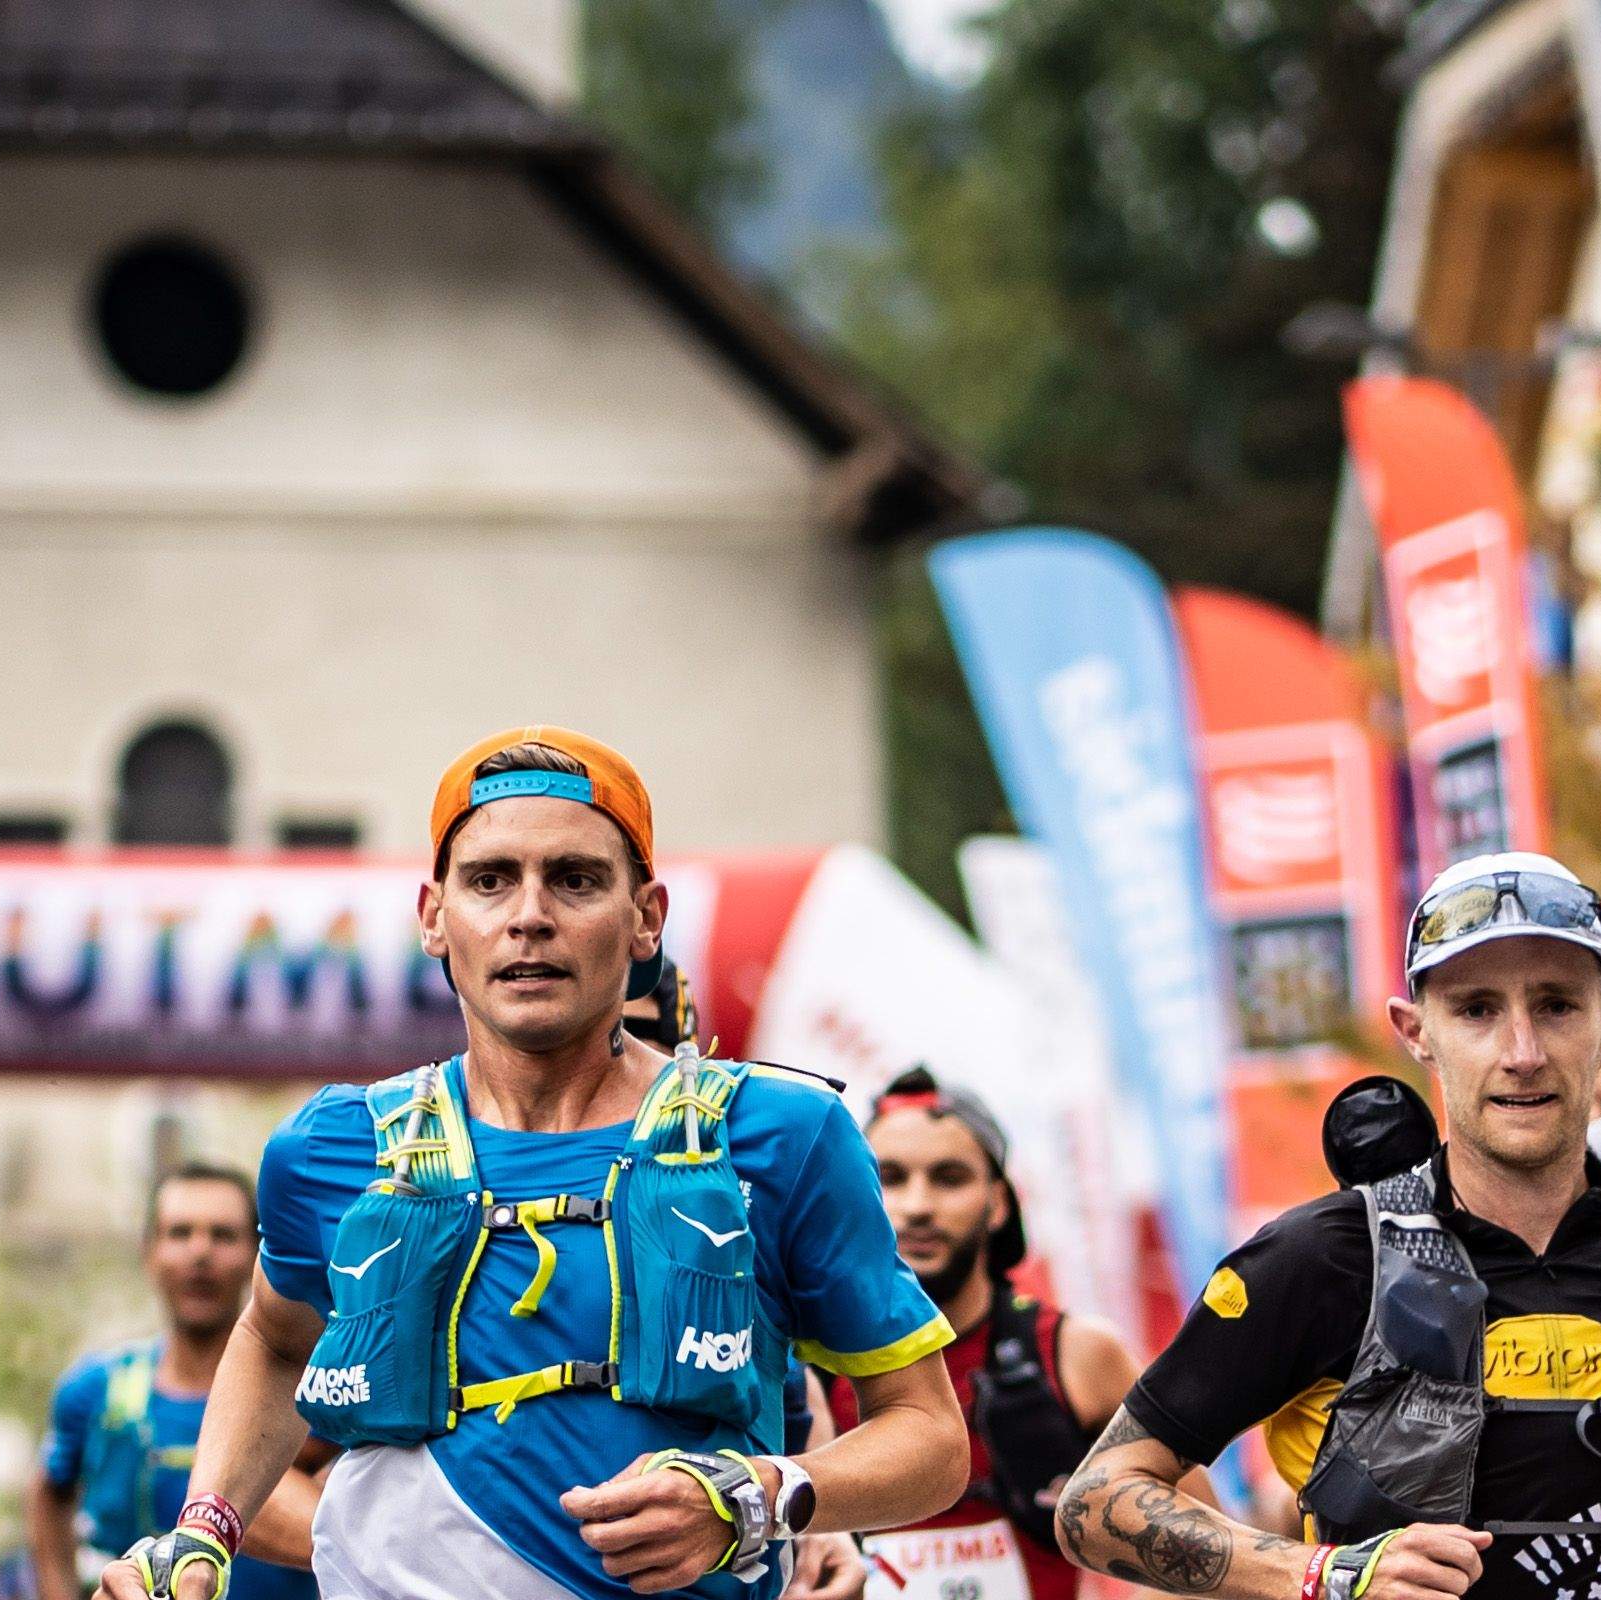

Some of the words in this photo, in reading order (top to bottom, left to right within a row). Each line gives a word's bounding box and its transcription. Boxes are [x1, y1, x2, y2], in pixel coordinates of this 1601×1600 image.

[326, 1364, 367, 1388] ONE
[328, 1381, 371, 1407] ONE
[1399, 1402, 1453, 1426] CAMELBAK
[184, 1505, 229, 1535] UTMB
